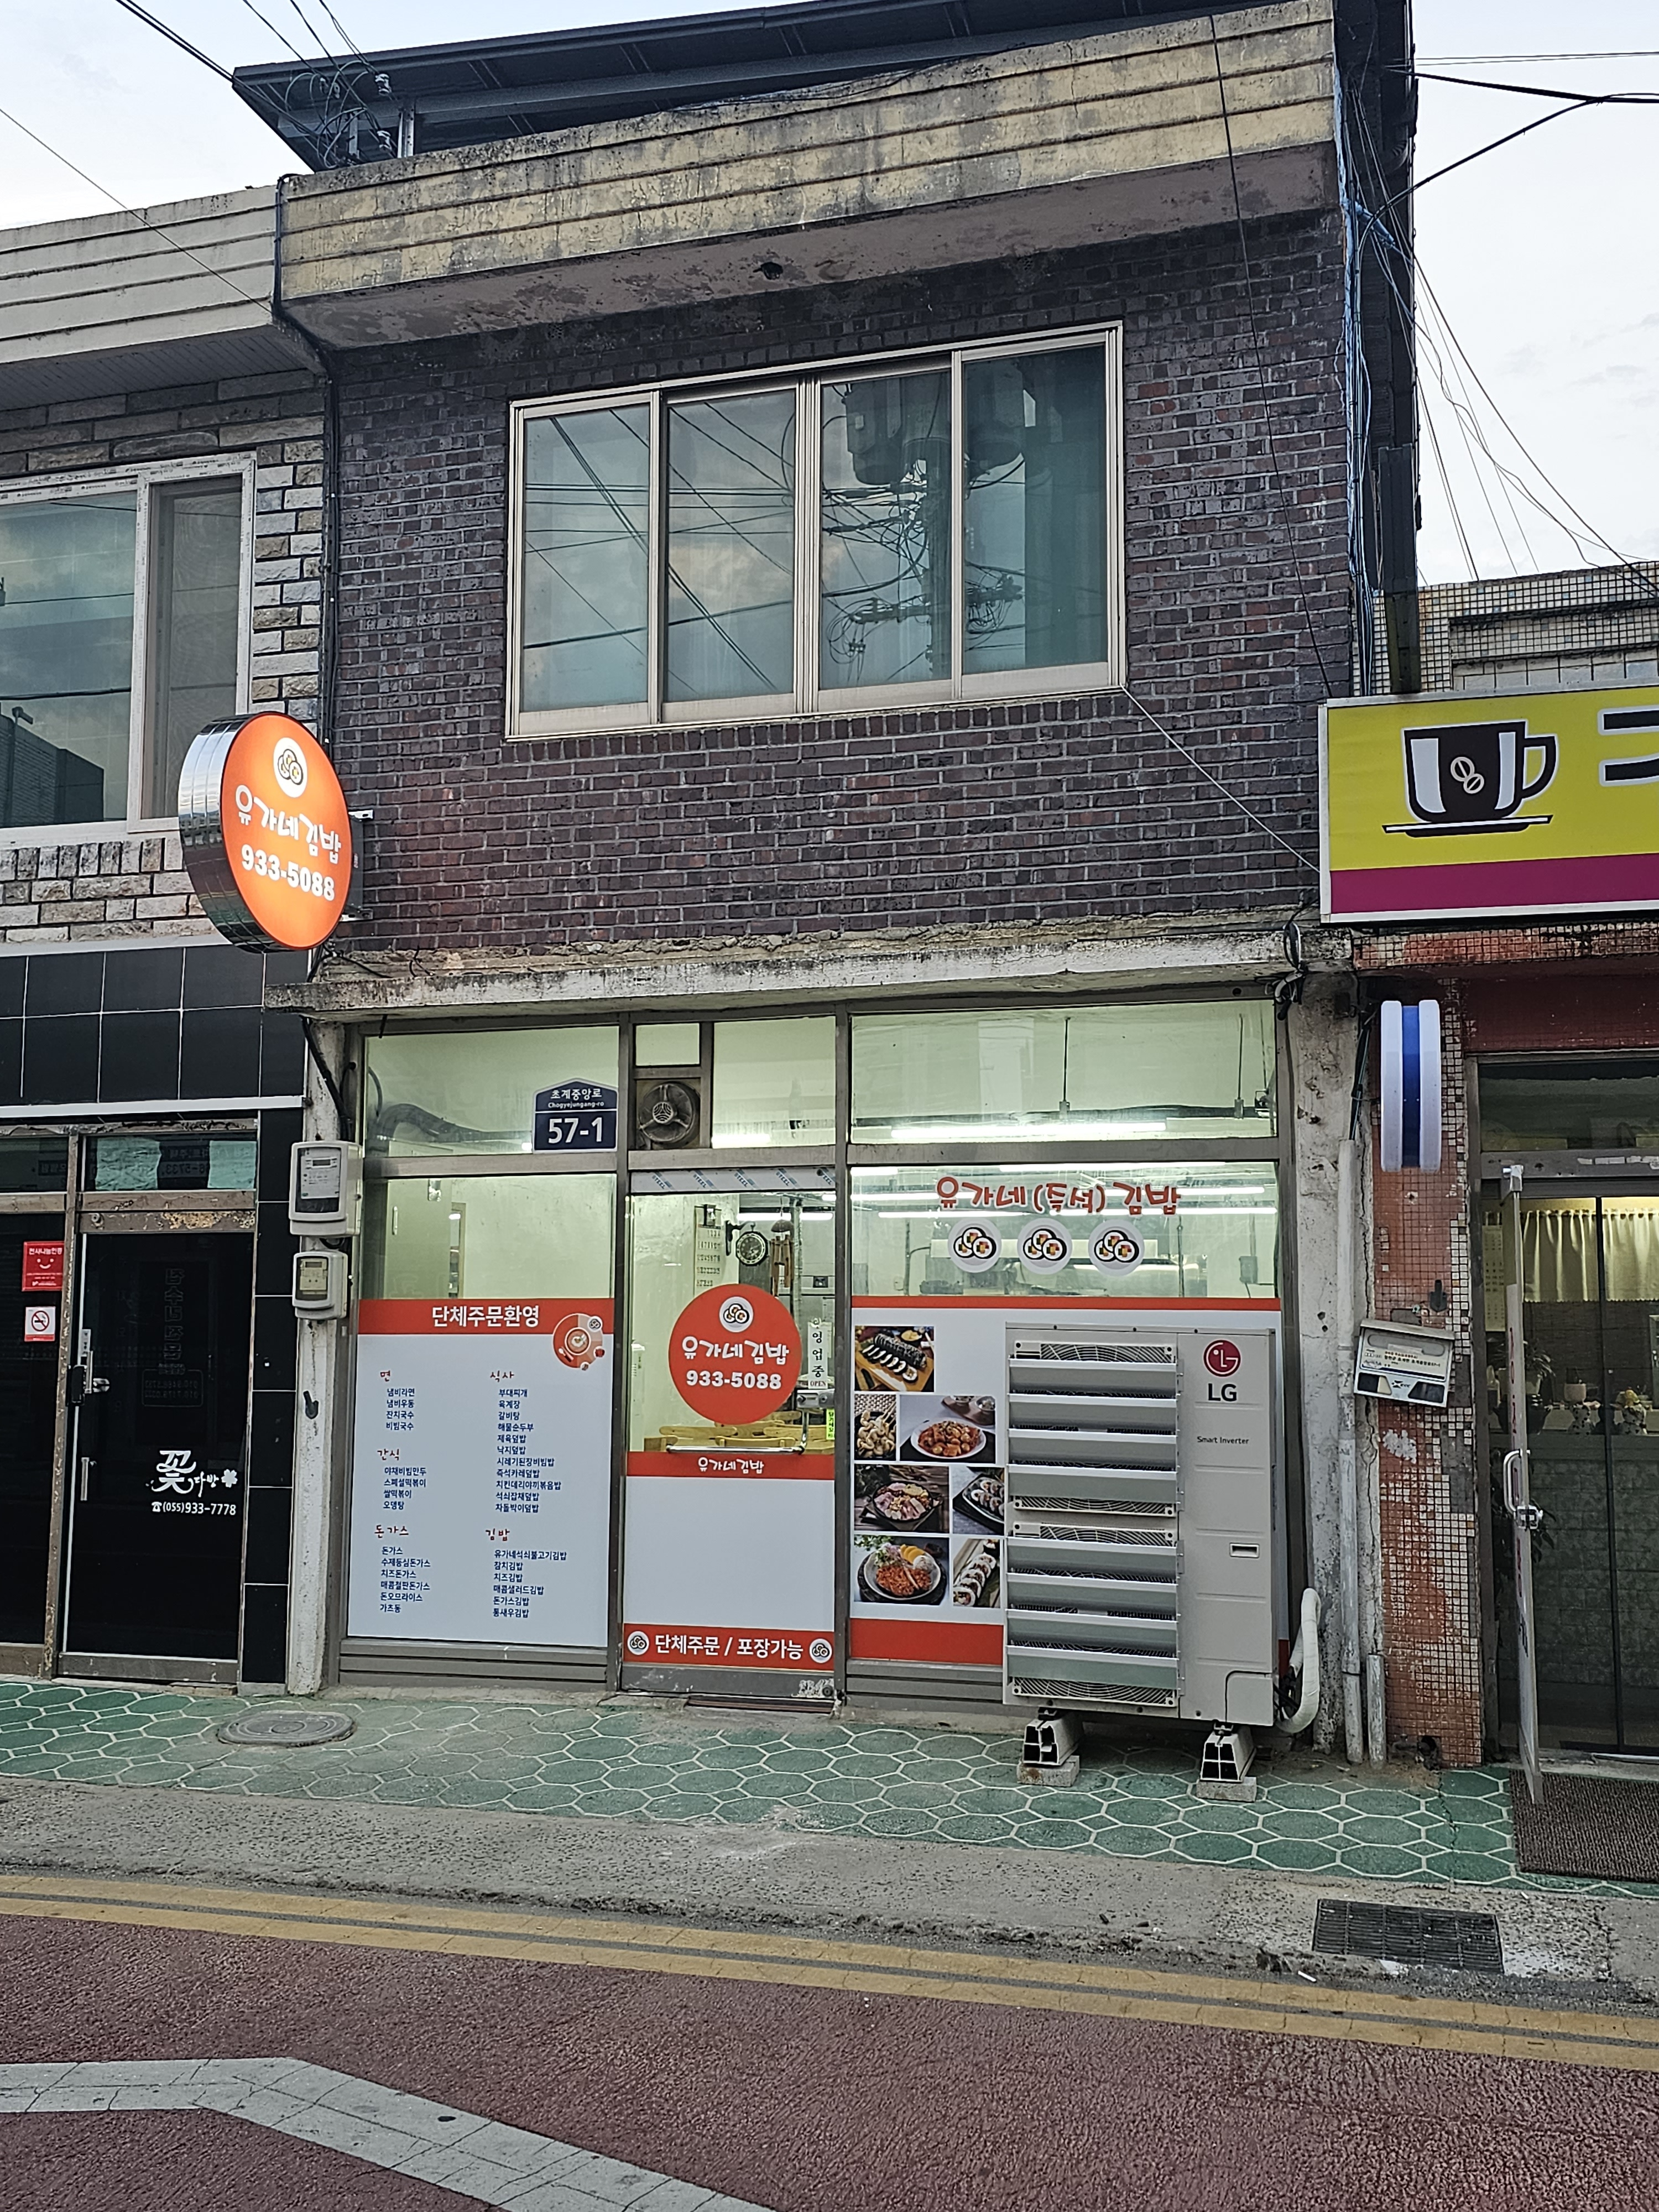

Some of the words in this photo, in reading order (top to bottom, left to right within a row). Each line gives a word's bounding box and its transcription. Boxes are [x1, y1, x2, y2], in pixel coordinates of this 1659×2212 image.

[236, 784, 342, 865] 유가네김밥
[241, 844, 335, 901] 933-5088
[550, 1088, 602, 1100] 초계중앙로
[547, 1101, 604, 1109] Chogyejungang-ro
[548, 1117, 602, 1144] 57-1
[937, 1176, 1026, 1208] 유가네
[1113, 1182, 1180, 1215] 김밥
[432, 1305, 540, 1328] 단체주문환영
[682, 1336, 790, 1365] 유가네김밥
[812, 1331, 825, 1378] 영업중
[380, 1370, 391, 1383] 면
[489, 1370, 515, 1383] 식사
[686, 1370, 781, 1390] 933-5088
[1208, 1383, 1237, 1402] LG
[387, 1399, 415, 1408] 냄비우동
[386, 1410, 414, 1420] 잔치국수
[498, 1411, 520, 1421] 갈비탕
[385, 1421, 414, 1431] 비빔국수
[498, 1423, 534, 1432] 해물순두부
[497, 1434, 526, 1444] 제육덮밥
[1219, 1436, 1250, 1444] Inverter
[377, 1448, 400, 1461] 간식
[497, 1446, 526, 1455] 낙지덮밥
[497, 1457, 555, 1467] 시레기된장비빔밥
[698, 1457, 764, 1474] 유가네김밥
[496, 1468, 540, 1479] 즉석카레덮밥
[383, 1489, 412, 1499] 쌀떡볶이
[495, 1491, 540, 1501] 석쇠잡채덮밥
[162, 1501, 237, 1516] (055)933-7778
[383, 1500, 405, 1510] 오뎅탕
[495, 1503, 539, 1514] 차돌박이덮밥
[374, 1524, 409, 1539] 돈가스
[485, 1528, 510, 1542] 김밥
[381, 1546, 403, 1556] 돈가스
[494, 1550, 567, 1561] 유가네석쇠불고기김밥
[381, 1557, 431, 1568] 수제등심돈가스
[494, 1561, 524, 1571] 참치김밥
[380, 1569, 417, 1579] 치즈돈가스
[493, 1572, 523, 1583] 치즈김밥
[380, 1592, 423, 1602] 돈오므라이스
[493, 1596, 530, 1606] 돈가스김밥
[379, 1603, 401, 1614] 가츠동
[492, 1608, 529, 1619] 통새우김밥
[655, 1634, 721, 1656] 단체주문
[724, 1637, 733, 1656] /
[737, 1638, 804, 1660] 포장가능
